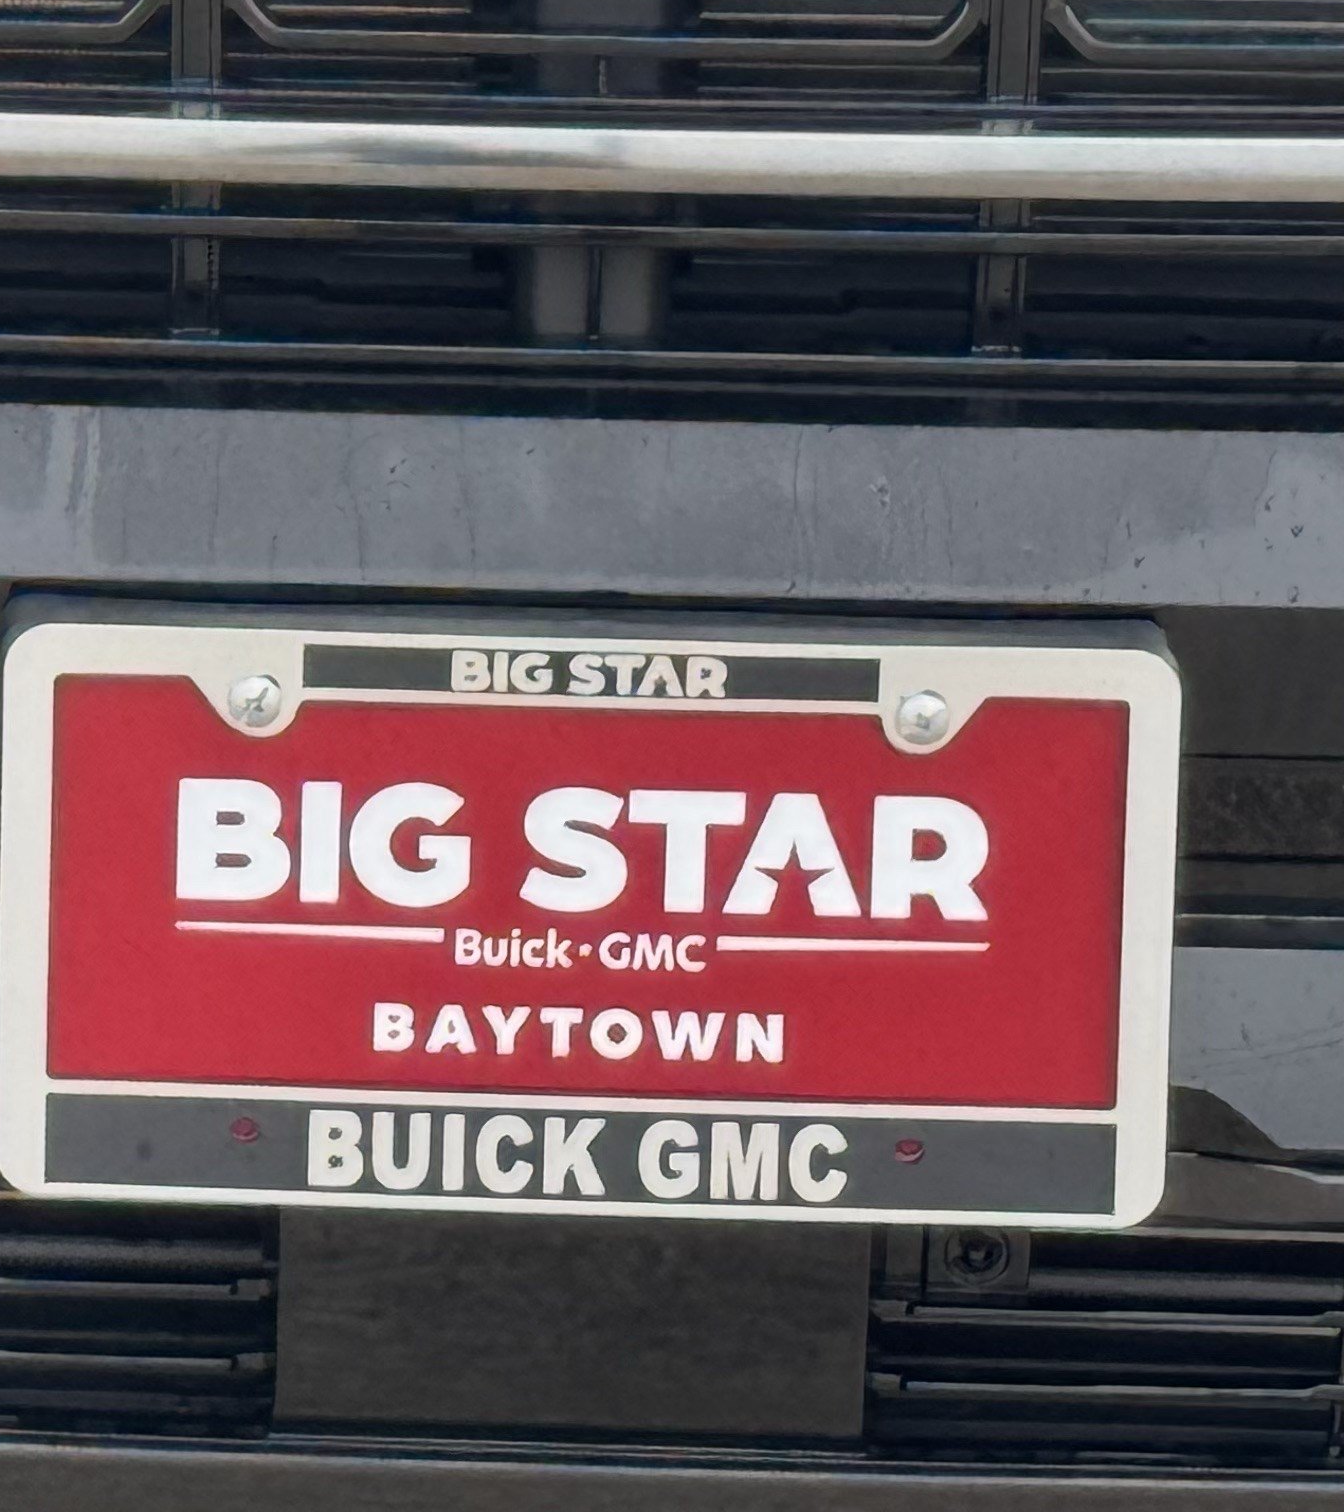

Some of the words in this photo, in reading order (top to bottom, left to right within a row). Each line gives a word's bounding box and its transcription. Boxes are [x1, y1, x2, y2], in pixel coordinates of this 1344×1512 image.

[450, 650, 554, 693] BIG
[566, 653, 728, 699] STAR
[175, 778, 472, 908] BIG
[519, 787, 990, 921] STAR
[372, 1002, 784, 1064] BAYTOWN
[307, 1109, 606, 1195] BUICK
[637, 1120, 849, 1202] GMC
